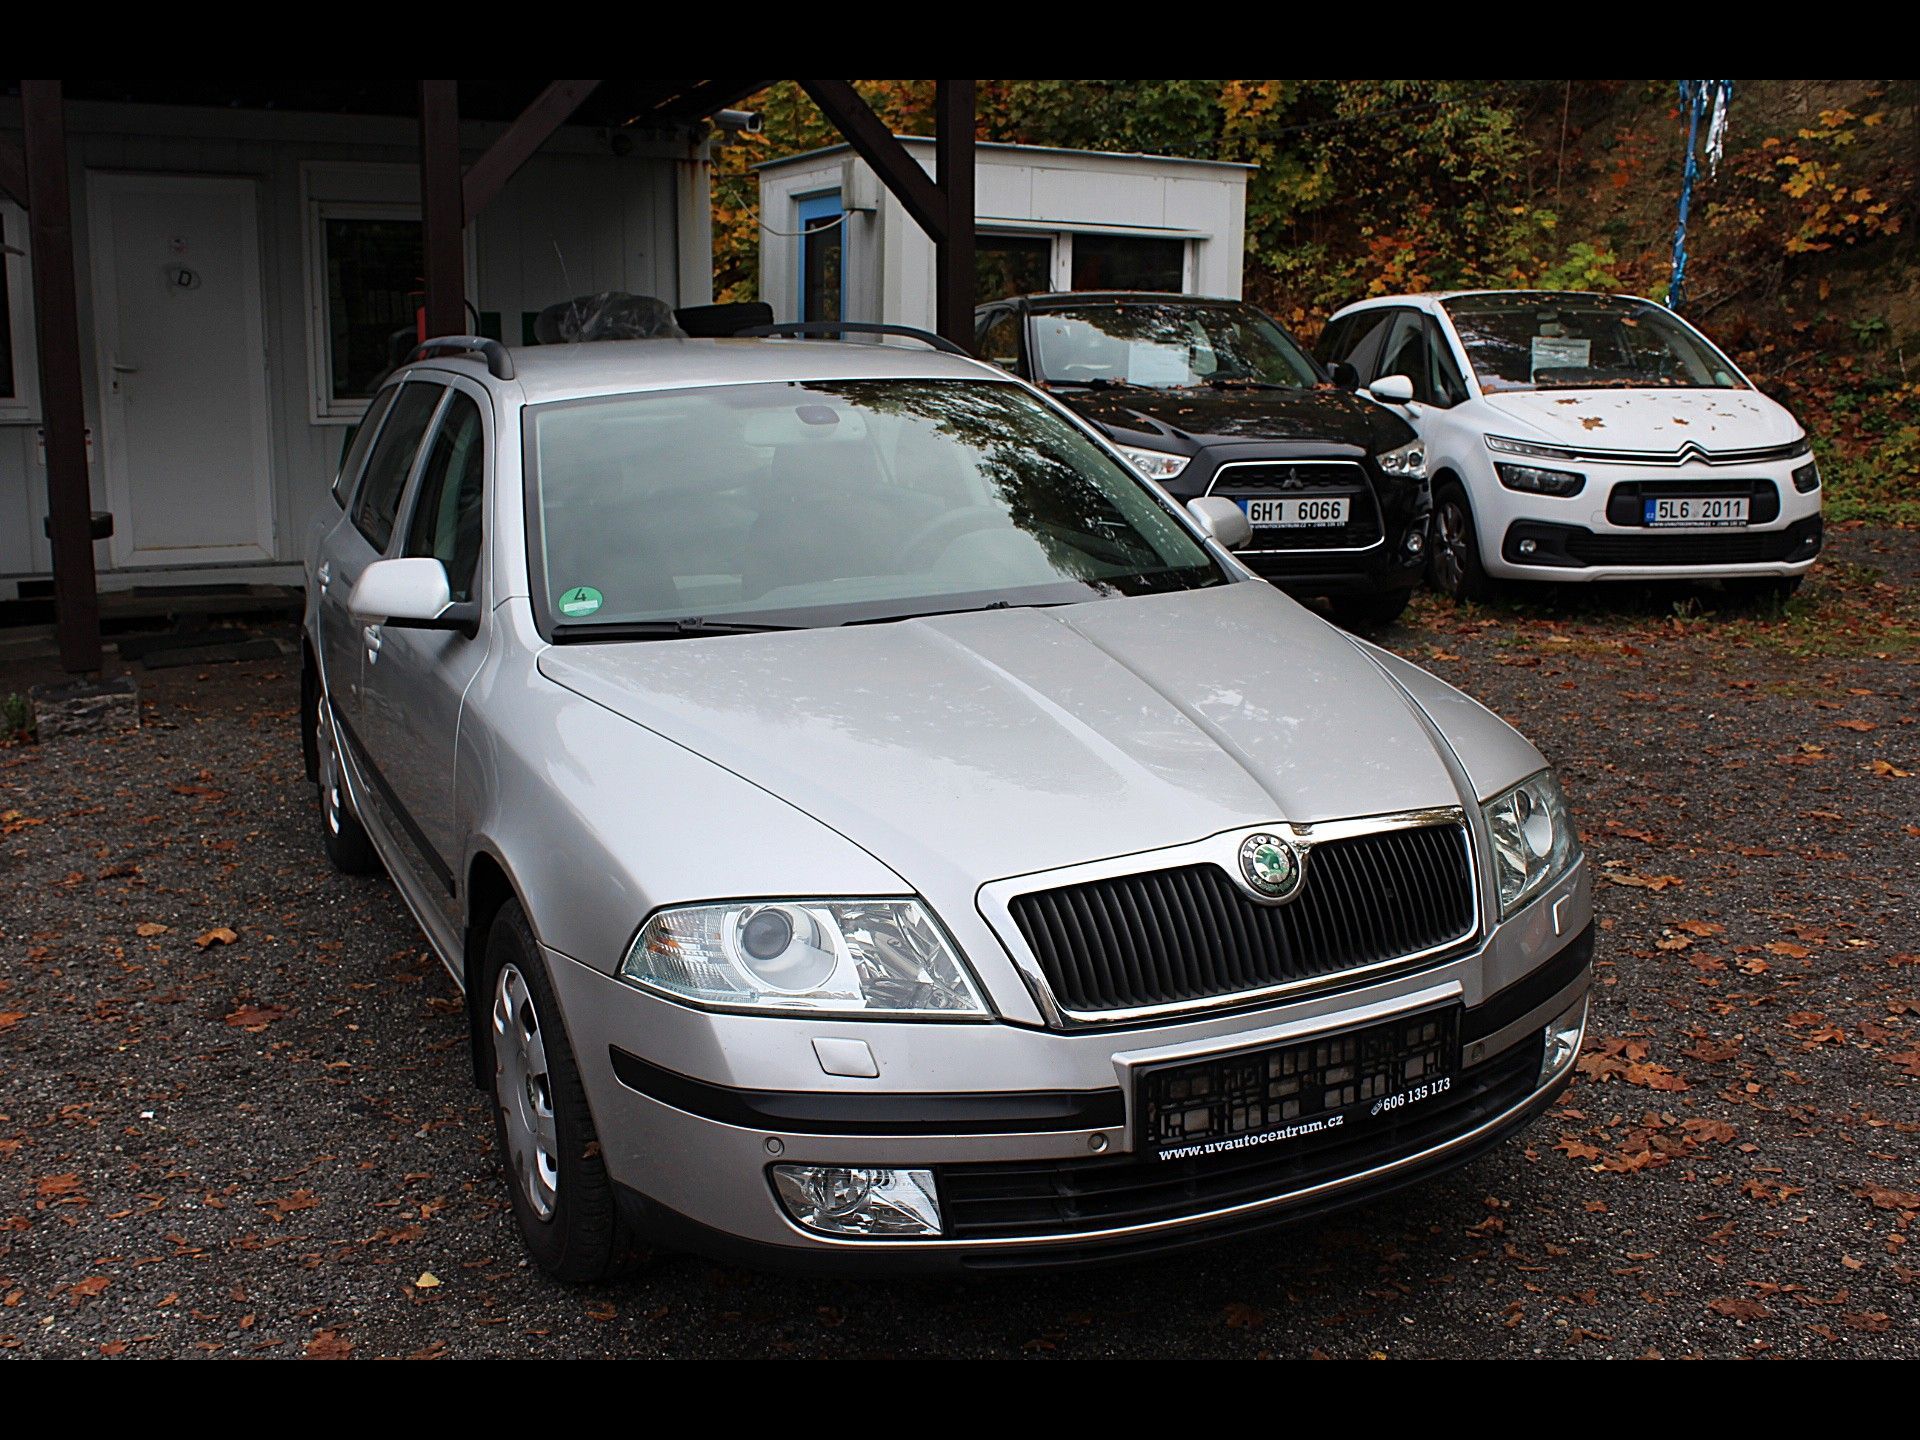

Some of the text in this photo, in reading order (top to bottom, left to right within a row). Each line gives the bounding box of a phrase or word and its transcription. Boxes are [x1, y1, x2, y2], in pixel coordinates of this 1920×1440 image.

[1251, 501, 1341, 521] 6H1 6066
[1659, 500, 1741, 518] 5L6 2011
[574, 588, 587, 601] 4
[1383, 1077, 1451, 1112] 606 135 173
[1158, 1113, 1344, 1161] www.uvautocentrum.cz
